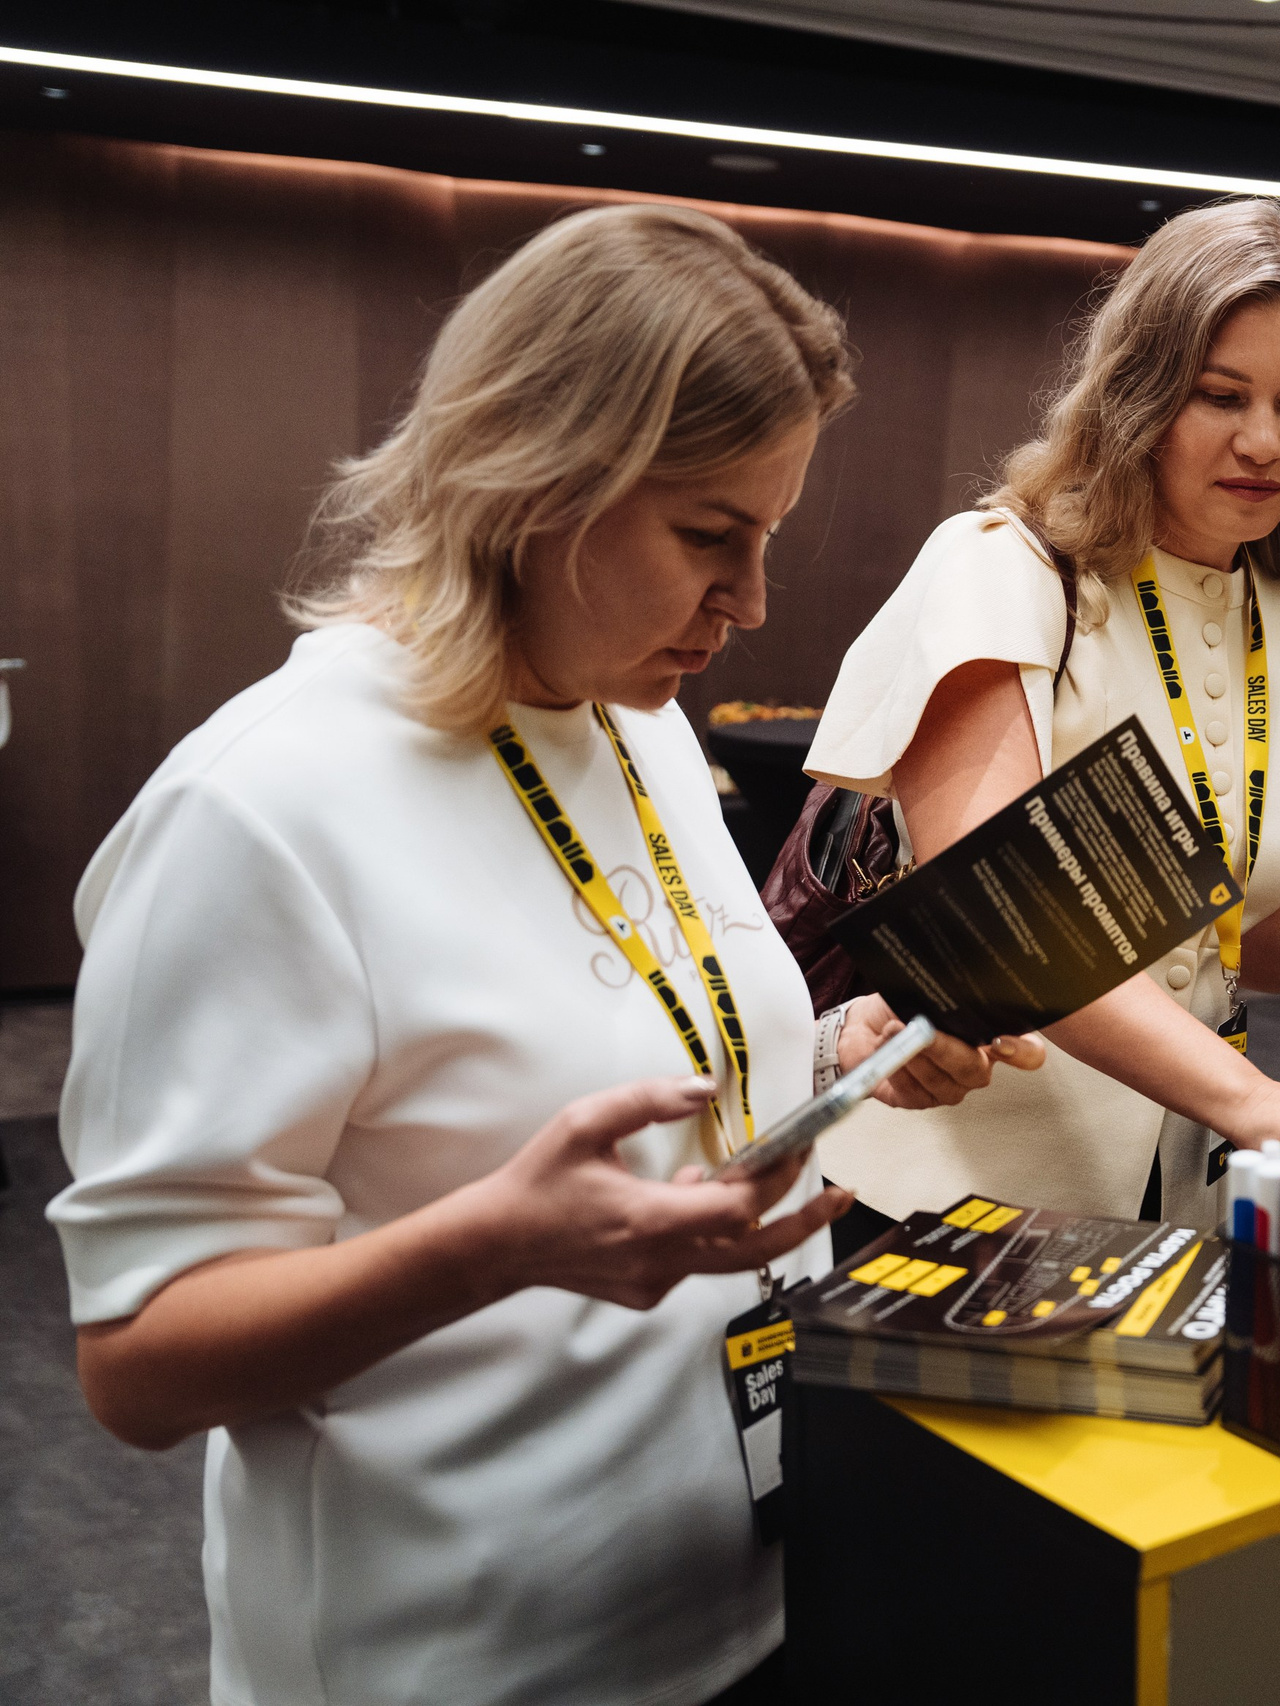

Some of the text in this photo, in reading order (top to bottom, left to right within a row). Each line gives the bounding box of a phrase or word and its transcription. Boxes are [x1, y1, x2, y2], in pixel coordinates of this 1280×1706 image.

[1247, 675, 1266, 744] SALES DAY
[1117, 729, 1200, 858] Правила игры
[648, 833, 700, 921] SALES DAY
[1025, 795, 1088, 886] Примеры
[1079, 882, 1138, 965] промптов
[744, 1359, 783, 1392] Sales
[748, 1382, 776, 1412] Day
